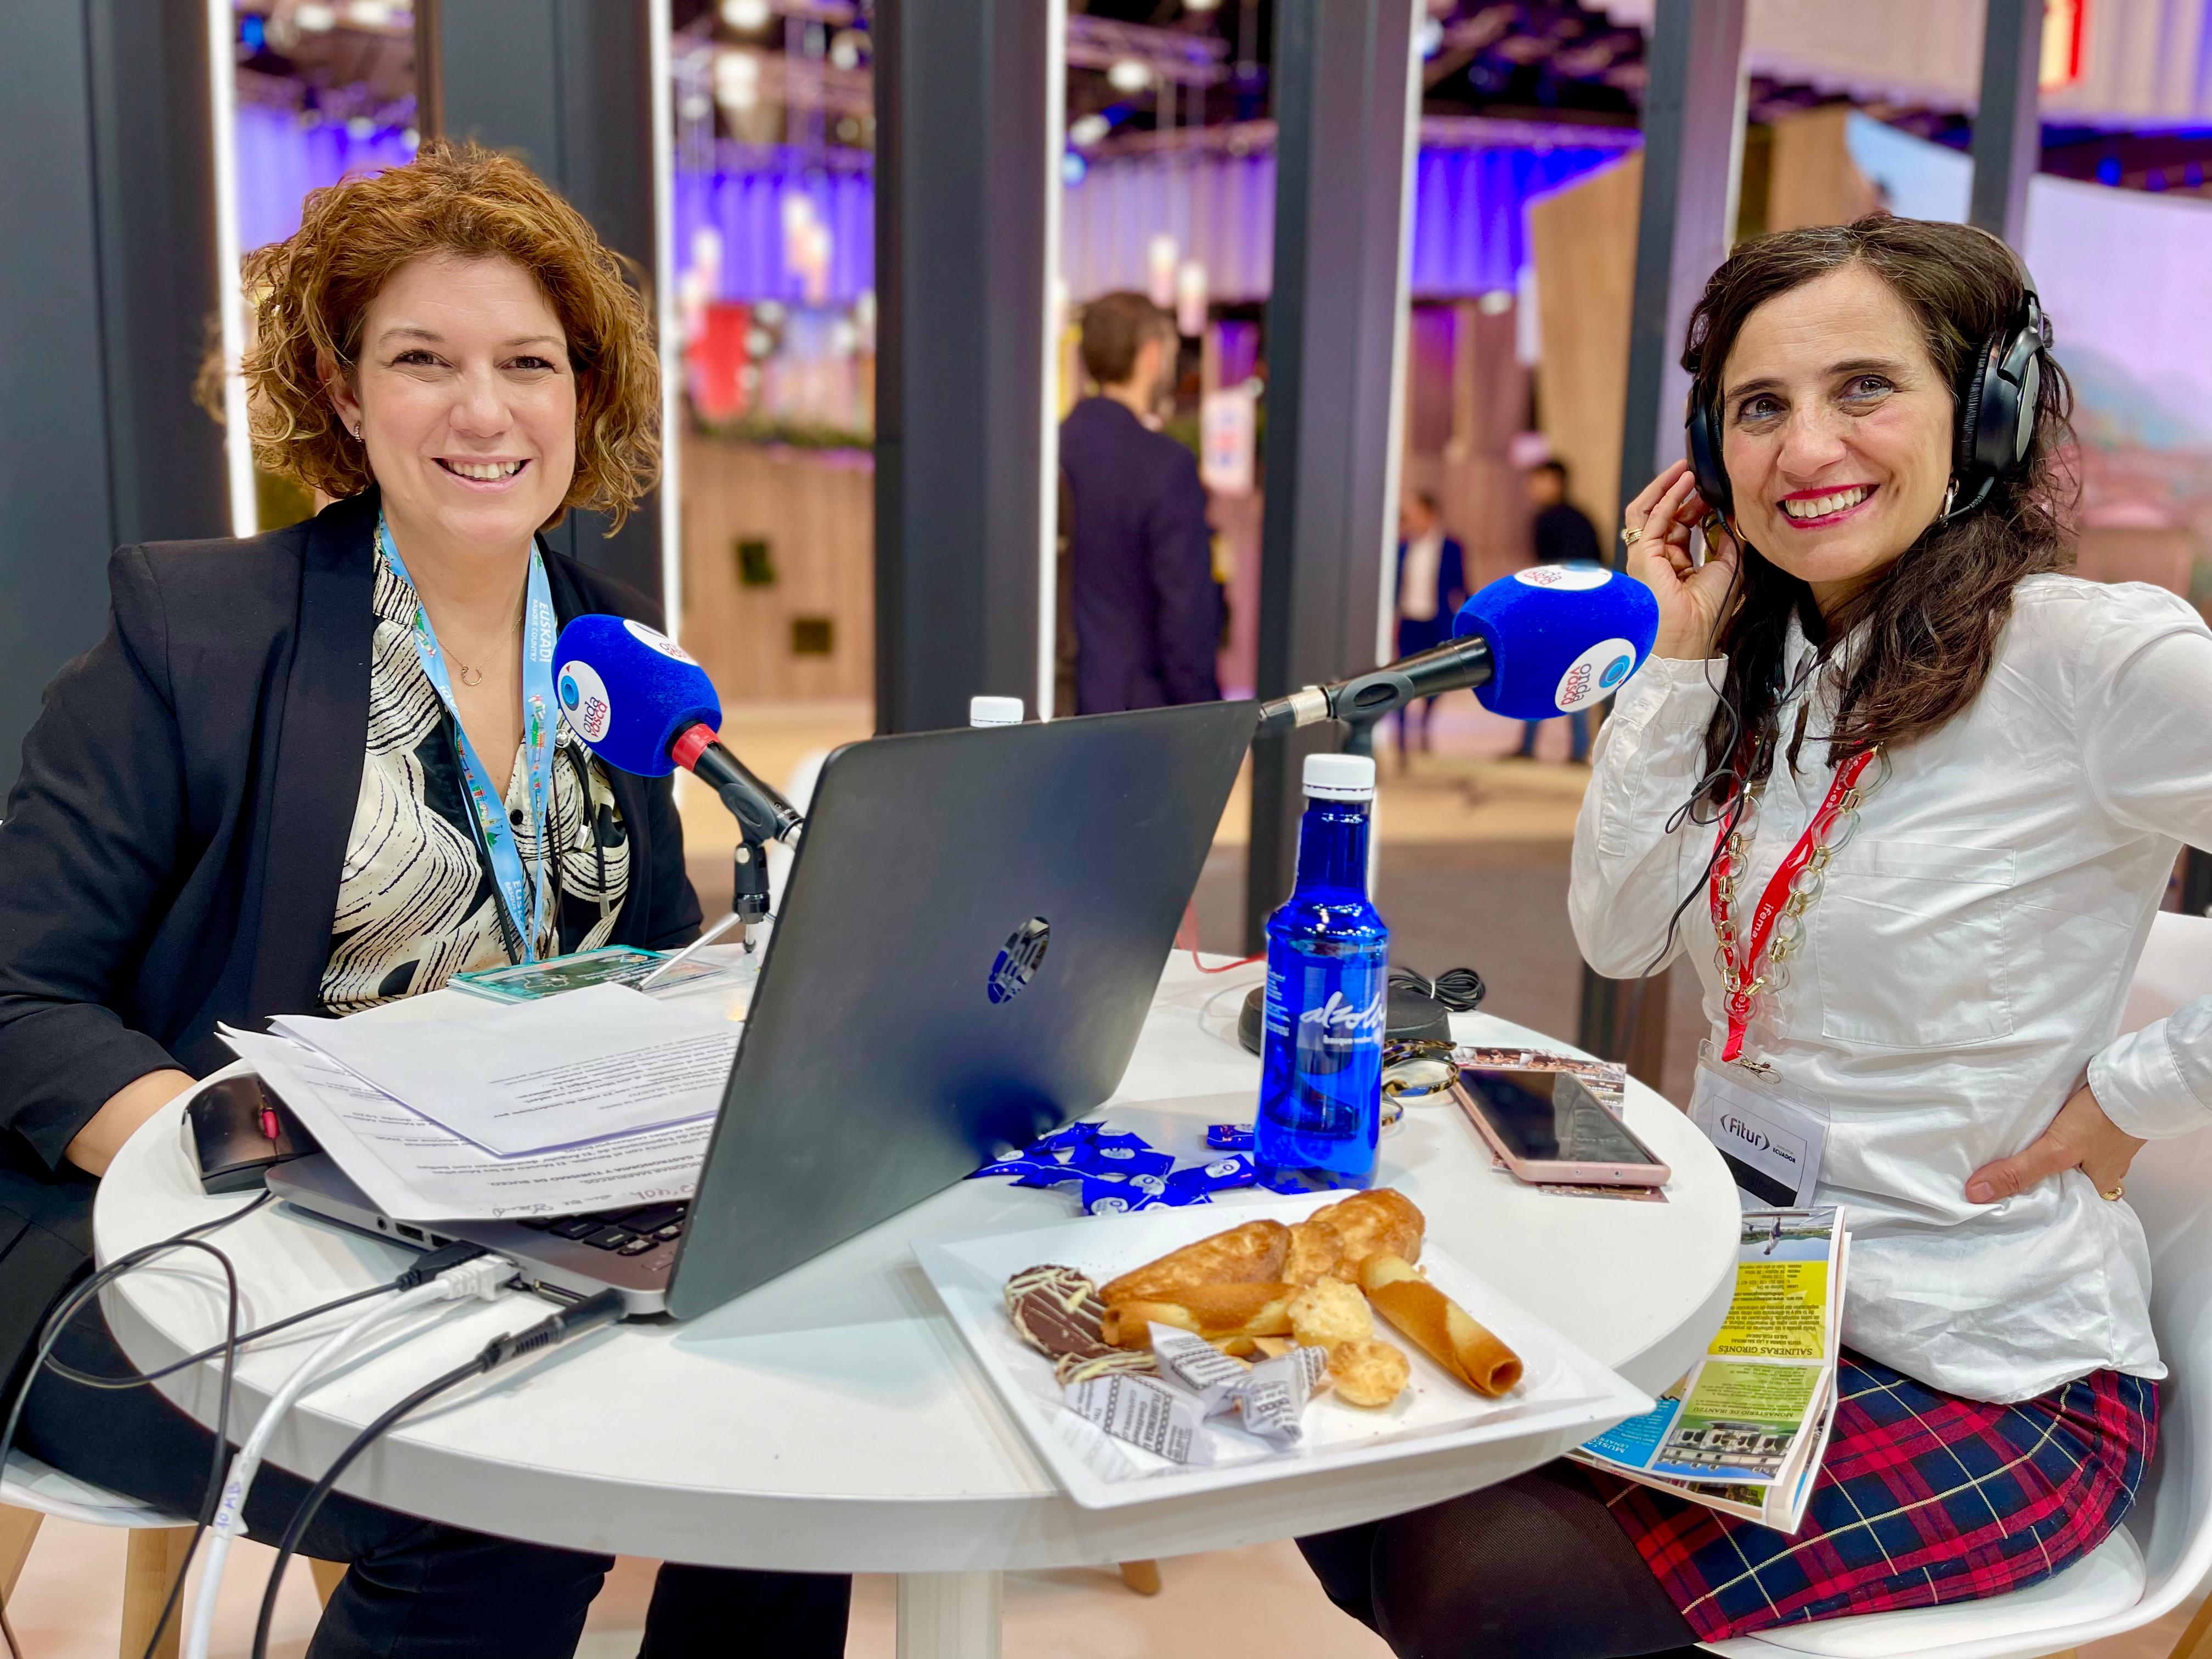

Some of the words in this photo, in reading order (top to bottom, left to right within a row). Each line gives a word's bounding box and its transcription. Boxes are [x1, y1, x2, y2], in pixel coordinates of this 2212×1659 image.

[539, 602, 552, 663] EUSKADI
[1560, 666, 1581, 706] vasca
[1575, 663, 1592, 703] onda
[583, 696, 601, 733] onda
[591, 701, 608, 738] vasca
[1751, 902, 1774, 940] ifema
[1729, 1117, 1762, 1147] Fitur
[1773, 1147, 1796, 1164] ECUADOR
[549, 1170, 601, 1181] TURISMO
[1718, 1345, 1757, 1355] GIRONÉS
[1760, 1346, 1812, 1356] SALINERAS
[1741, 1409, 1793, 1418] MONASTERIO
